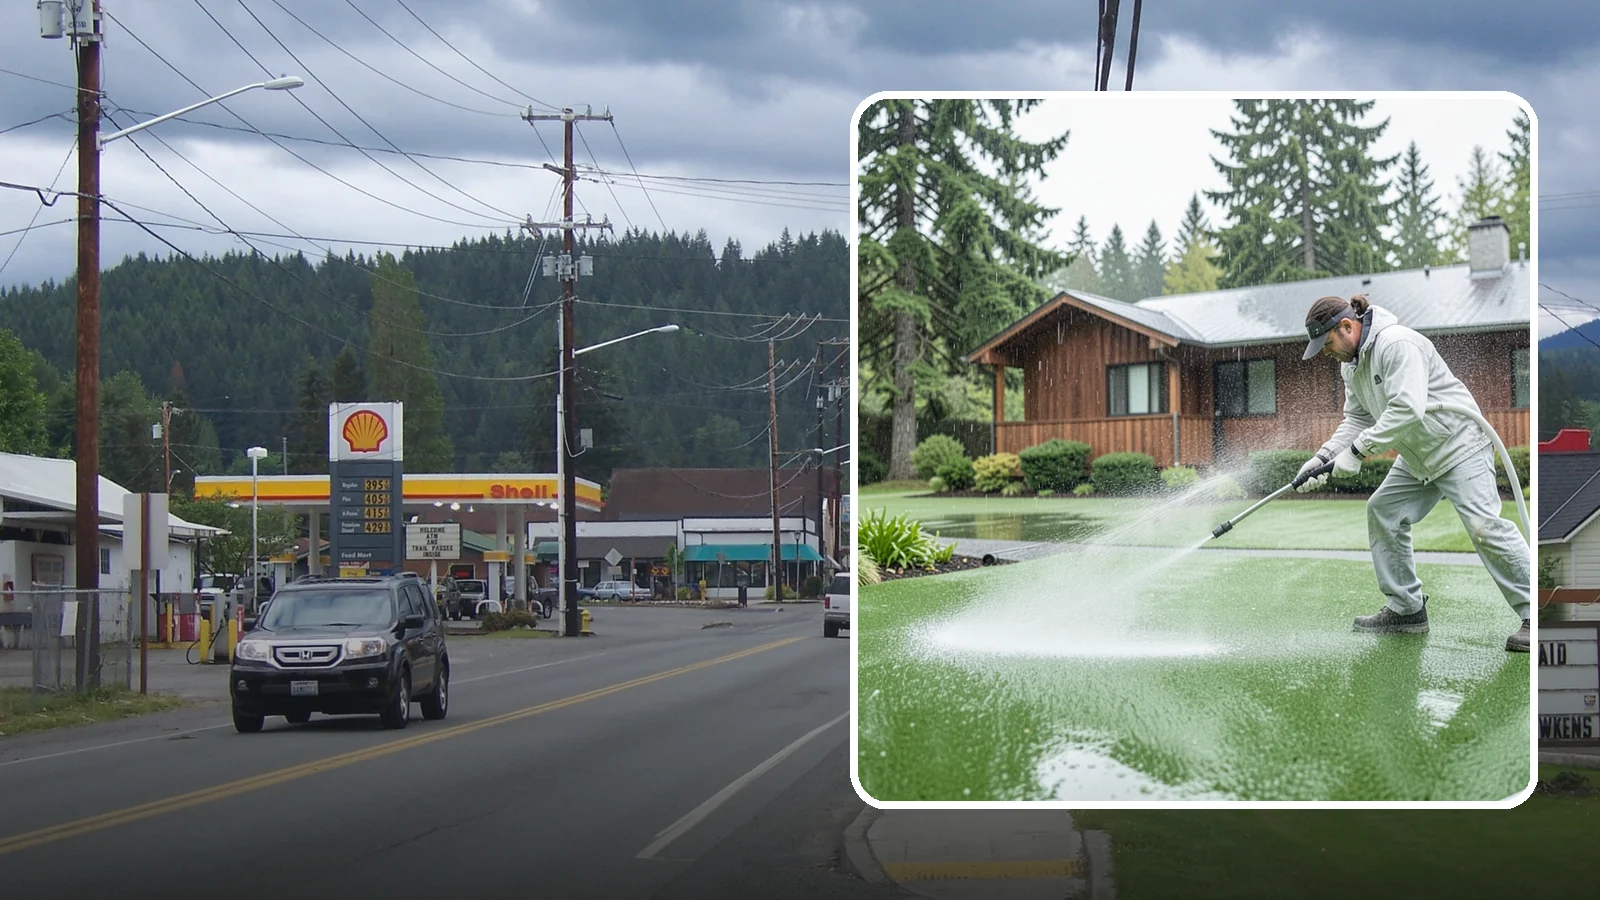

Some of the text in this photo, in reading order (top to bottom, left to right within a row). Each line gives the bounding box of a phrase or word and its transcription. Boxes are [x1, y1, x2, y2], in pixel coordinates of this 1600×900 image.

[365, 480, 383, 490] 395
[490, 484, 547, 499] Shell
[365, 494, 383, 504] 405
[365, 508, 383, 518] 415
[365, 522, 383, 532] 429
[1538, 643, 1567, 665] AID
